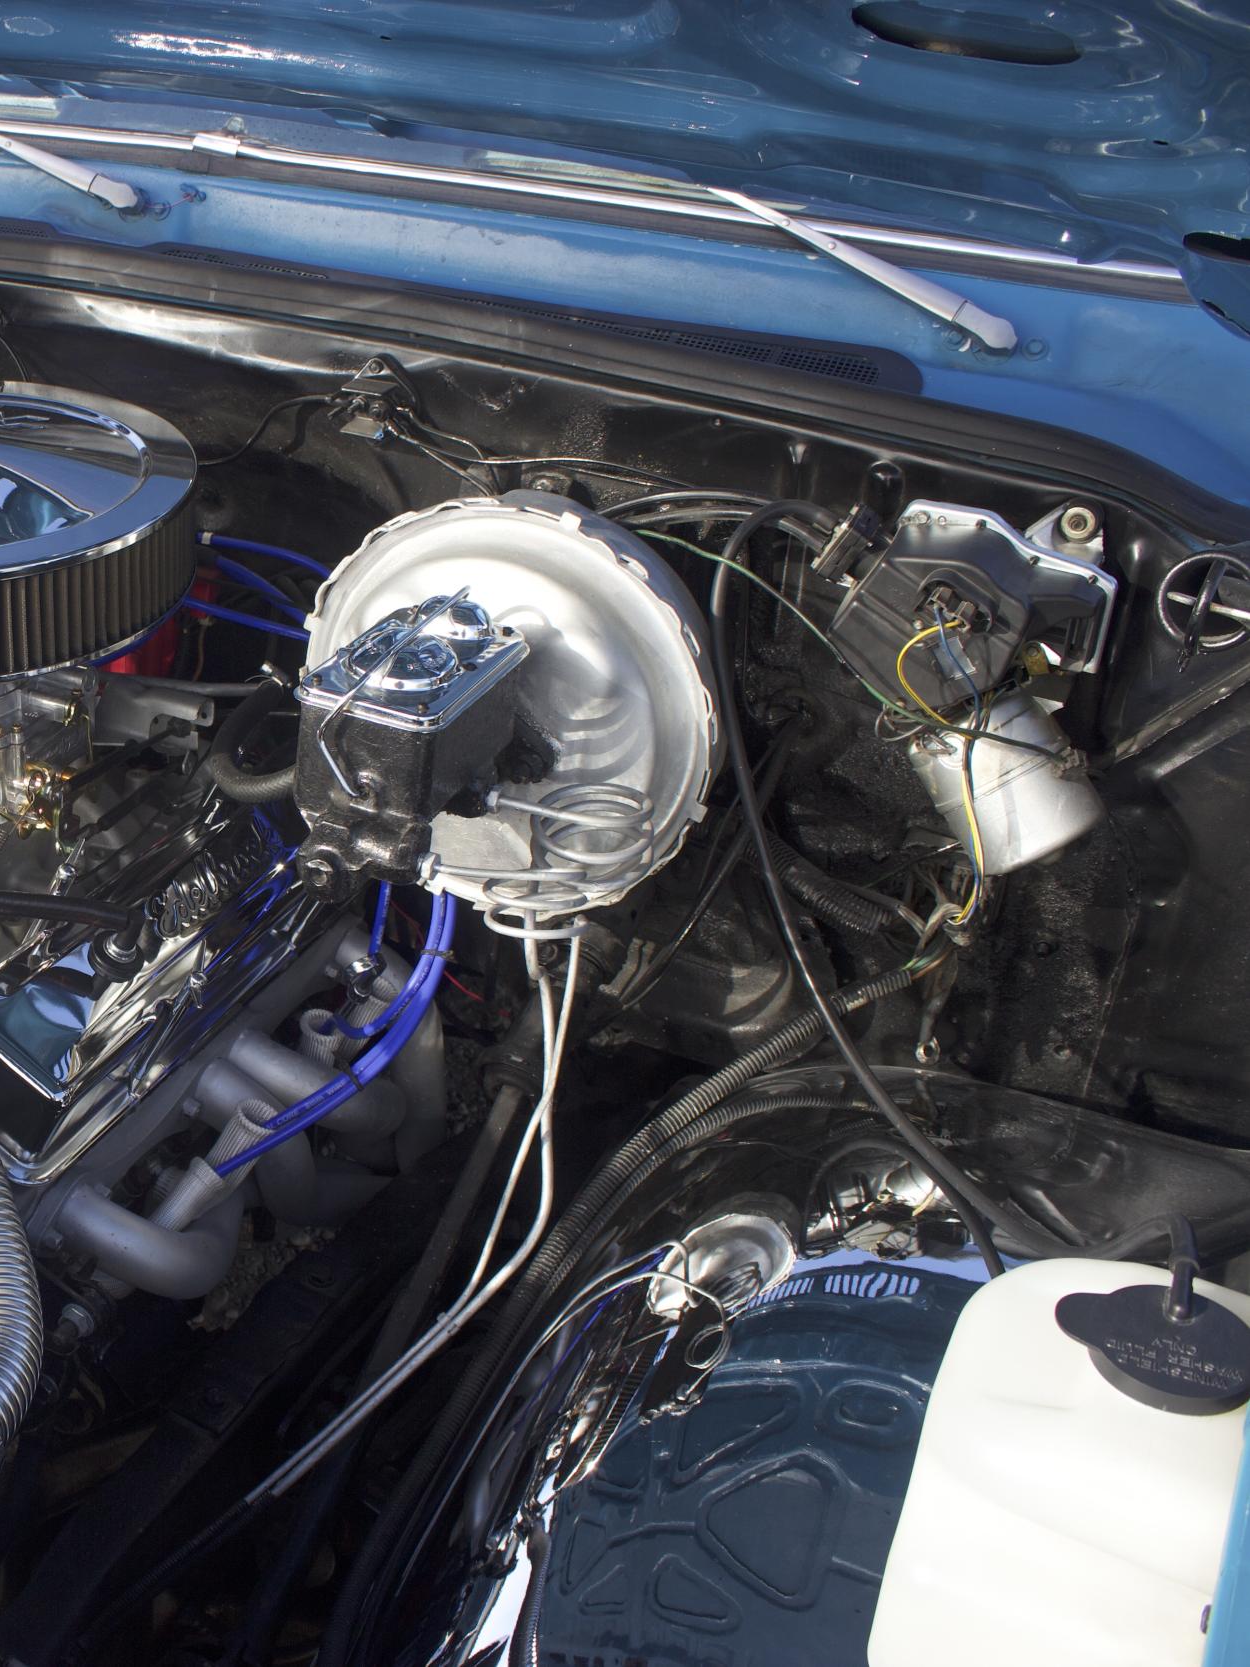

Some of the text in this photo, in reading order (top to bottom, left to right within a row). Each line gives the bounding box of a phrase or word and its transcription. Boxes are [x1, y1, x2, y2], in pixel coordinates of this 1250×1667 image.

[1106, 1339, 1243, 1382] WASHER FLUID
[1151, 1337, 1197, 1355] ONLY
[1116, 1353, 1228, 1390] WINDSHIELD
